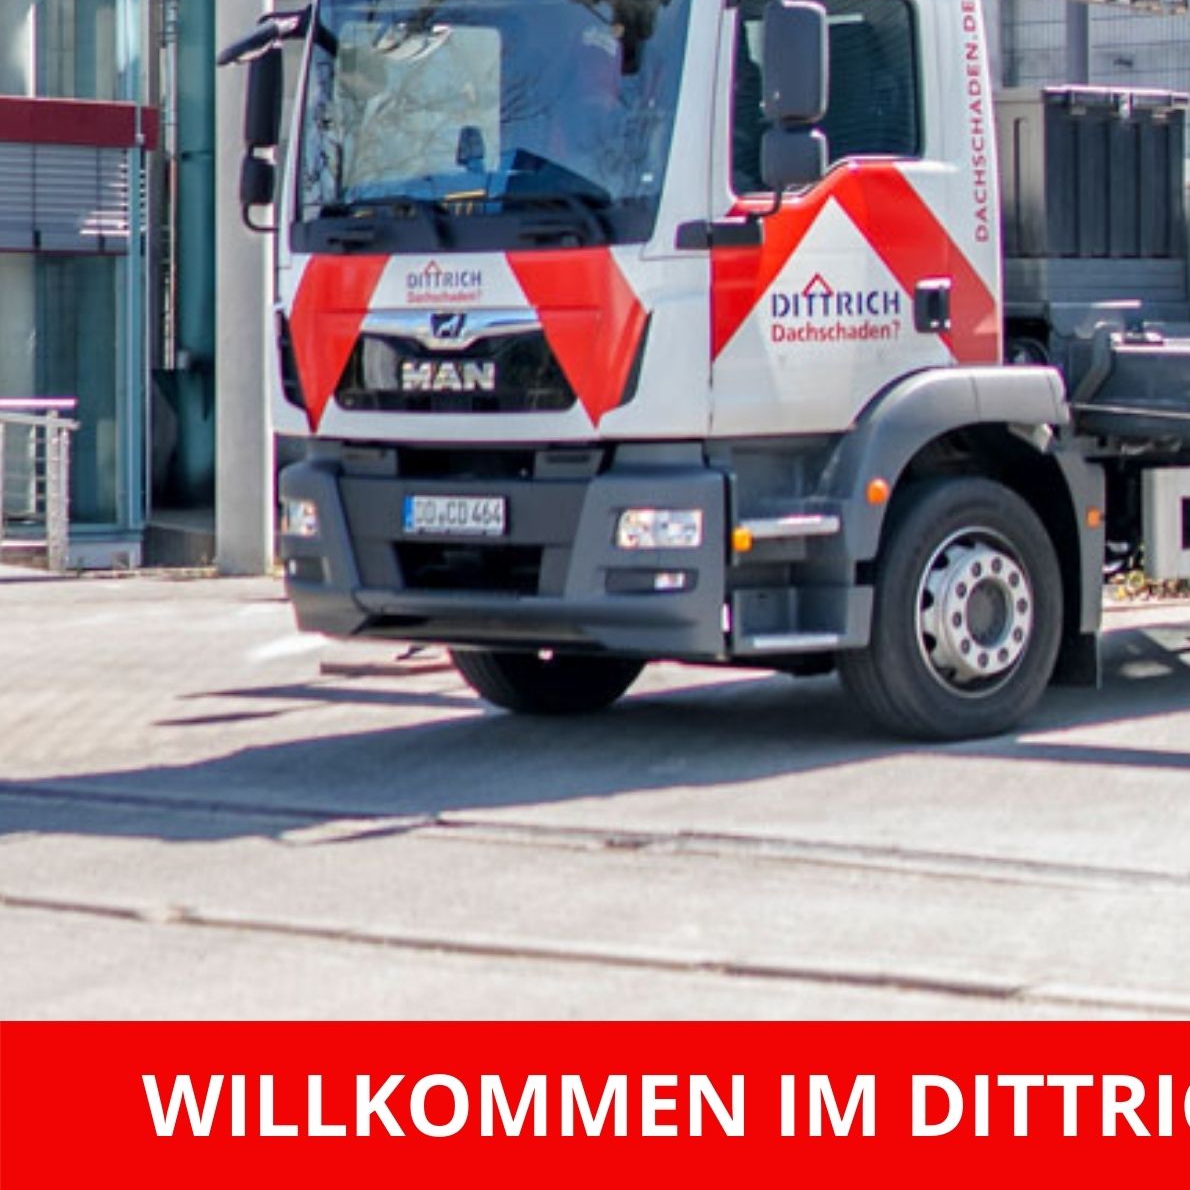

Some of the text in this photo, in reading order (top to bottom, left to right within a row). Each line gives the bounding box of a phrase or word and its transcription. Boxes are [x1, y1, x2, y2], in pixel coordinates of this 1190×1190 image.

[407, 270, 482, 288] DITTRICH
[771, 289, 900, 318] DITTRICH
[771, 319, 900, 343] Dachschaden?
[402, 361, 496, 392] MAN
